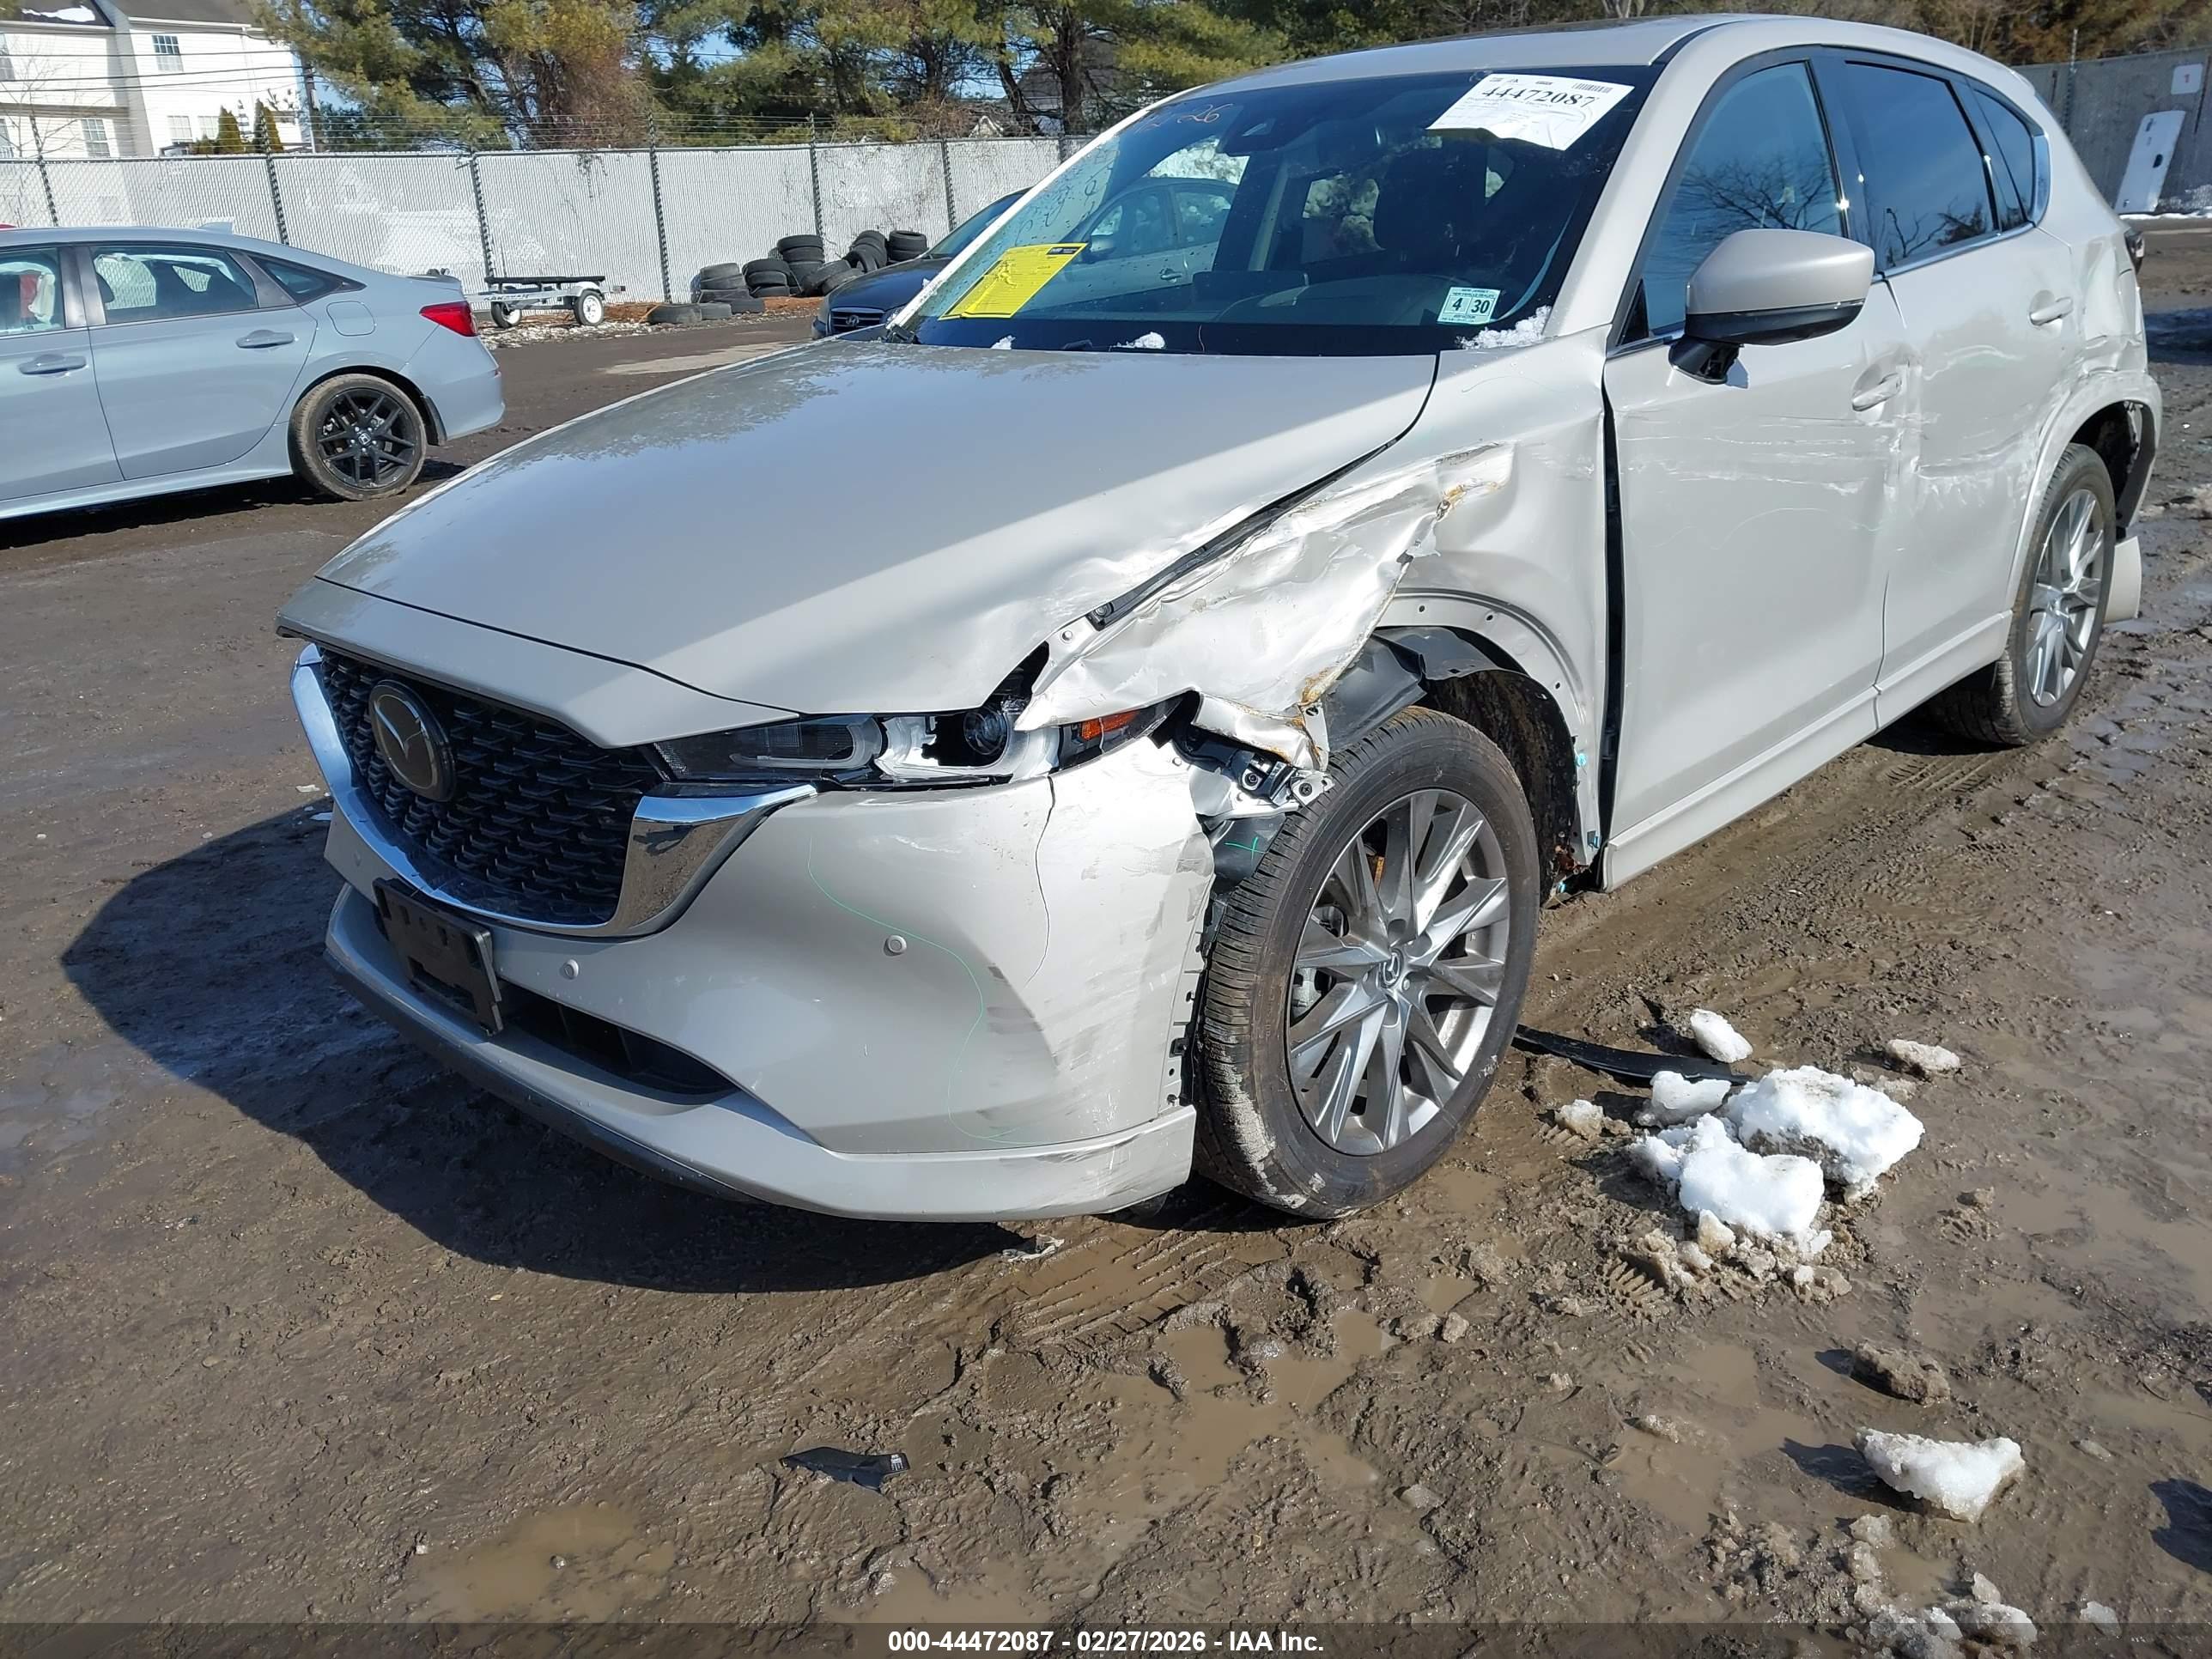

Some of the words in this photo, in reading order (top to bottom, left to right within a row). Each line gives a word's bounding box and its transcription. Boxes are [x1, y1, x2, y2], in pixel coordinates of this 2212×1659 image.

[1481, 86, 1597, 108] 44472087
[1453, 297, 1463, 311] 4
[1471, 299, 1491, 313] 30
